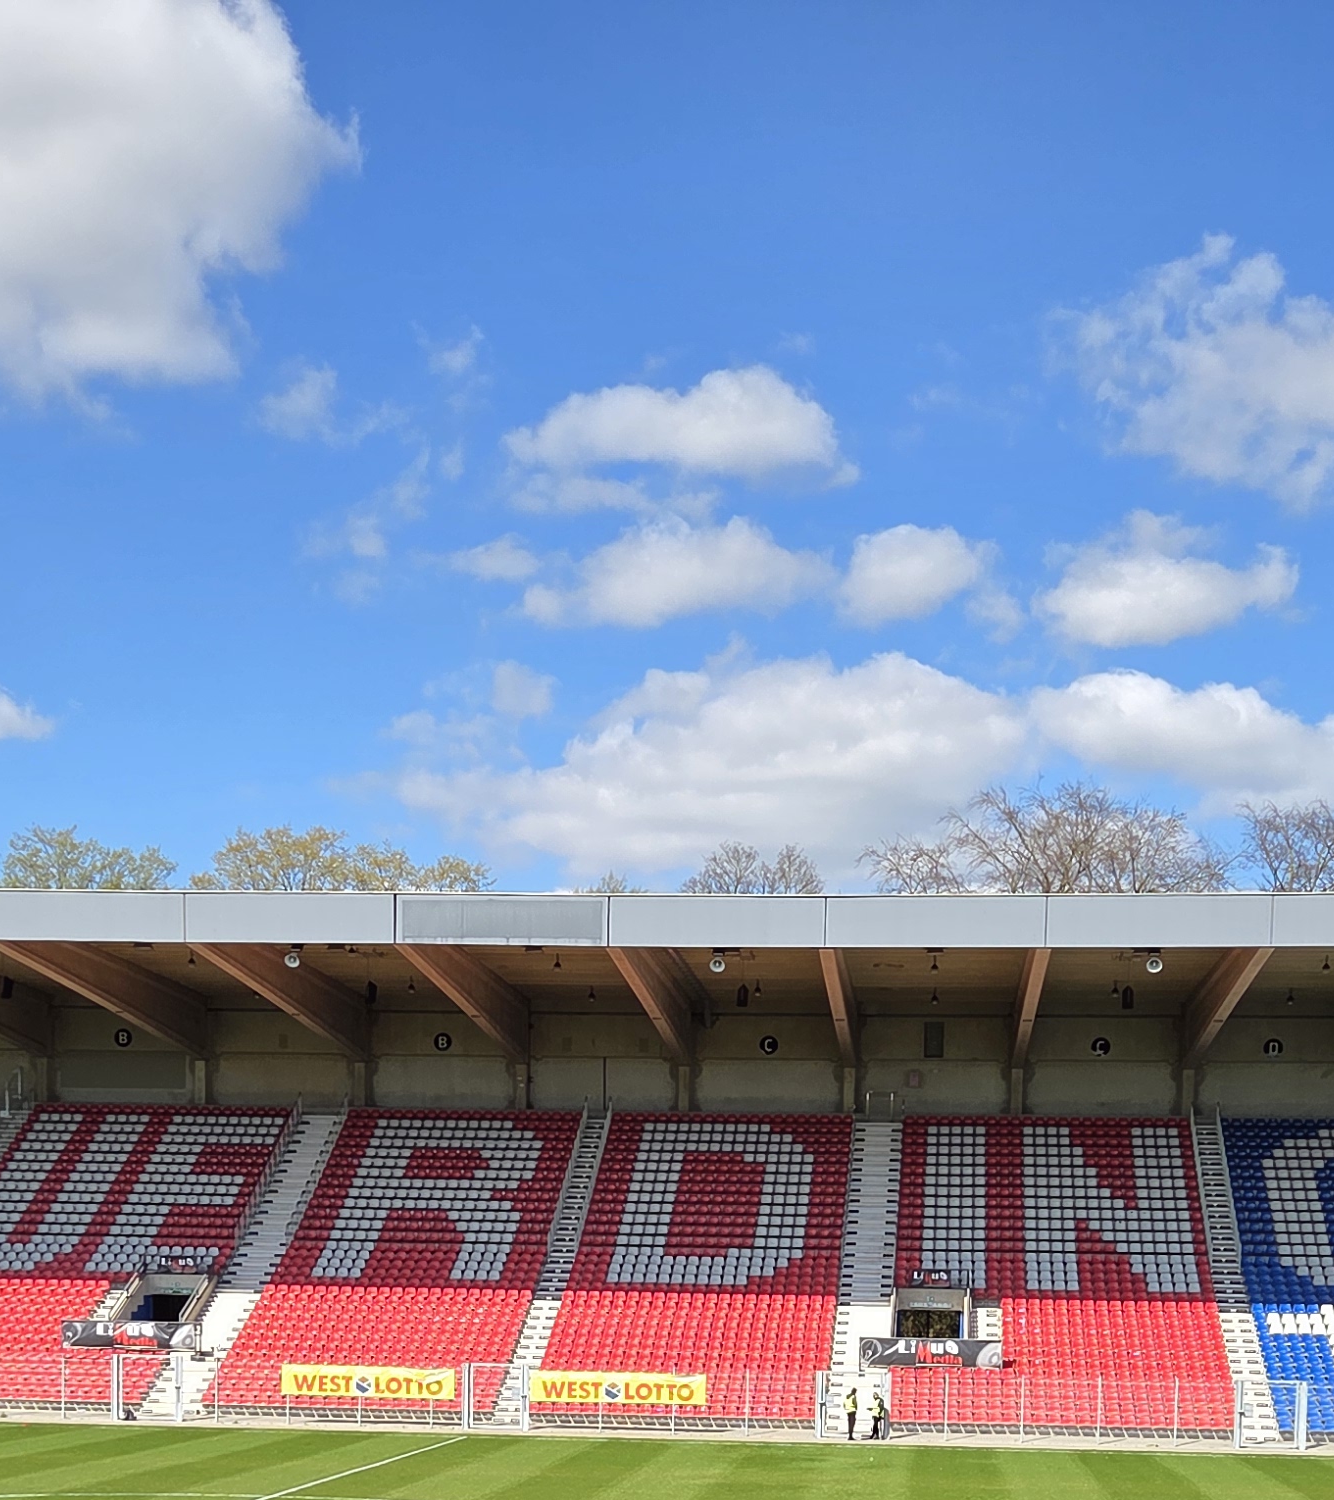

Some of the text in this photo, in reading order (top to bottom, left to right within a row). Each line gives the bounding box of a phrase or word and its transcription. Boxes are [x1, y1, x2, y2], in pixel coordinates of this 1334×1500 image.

[118, 1031, 128, 1044] B
[438, 1036, 448, 1048] B
[764, 1038, 773, 1052] C
[1096, 1040, 1105, 1054] C
[1268, 1041, 1279, 1055] D
[293, 1374, 443, 1396] WEST LOTTO
[542, 1380, 695, 1402] WEST LOTTO
